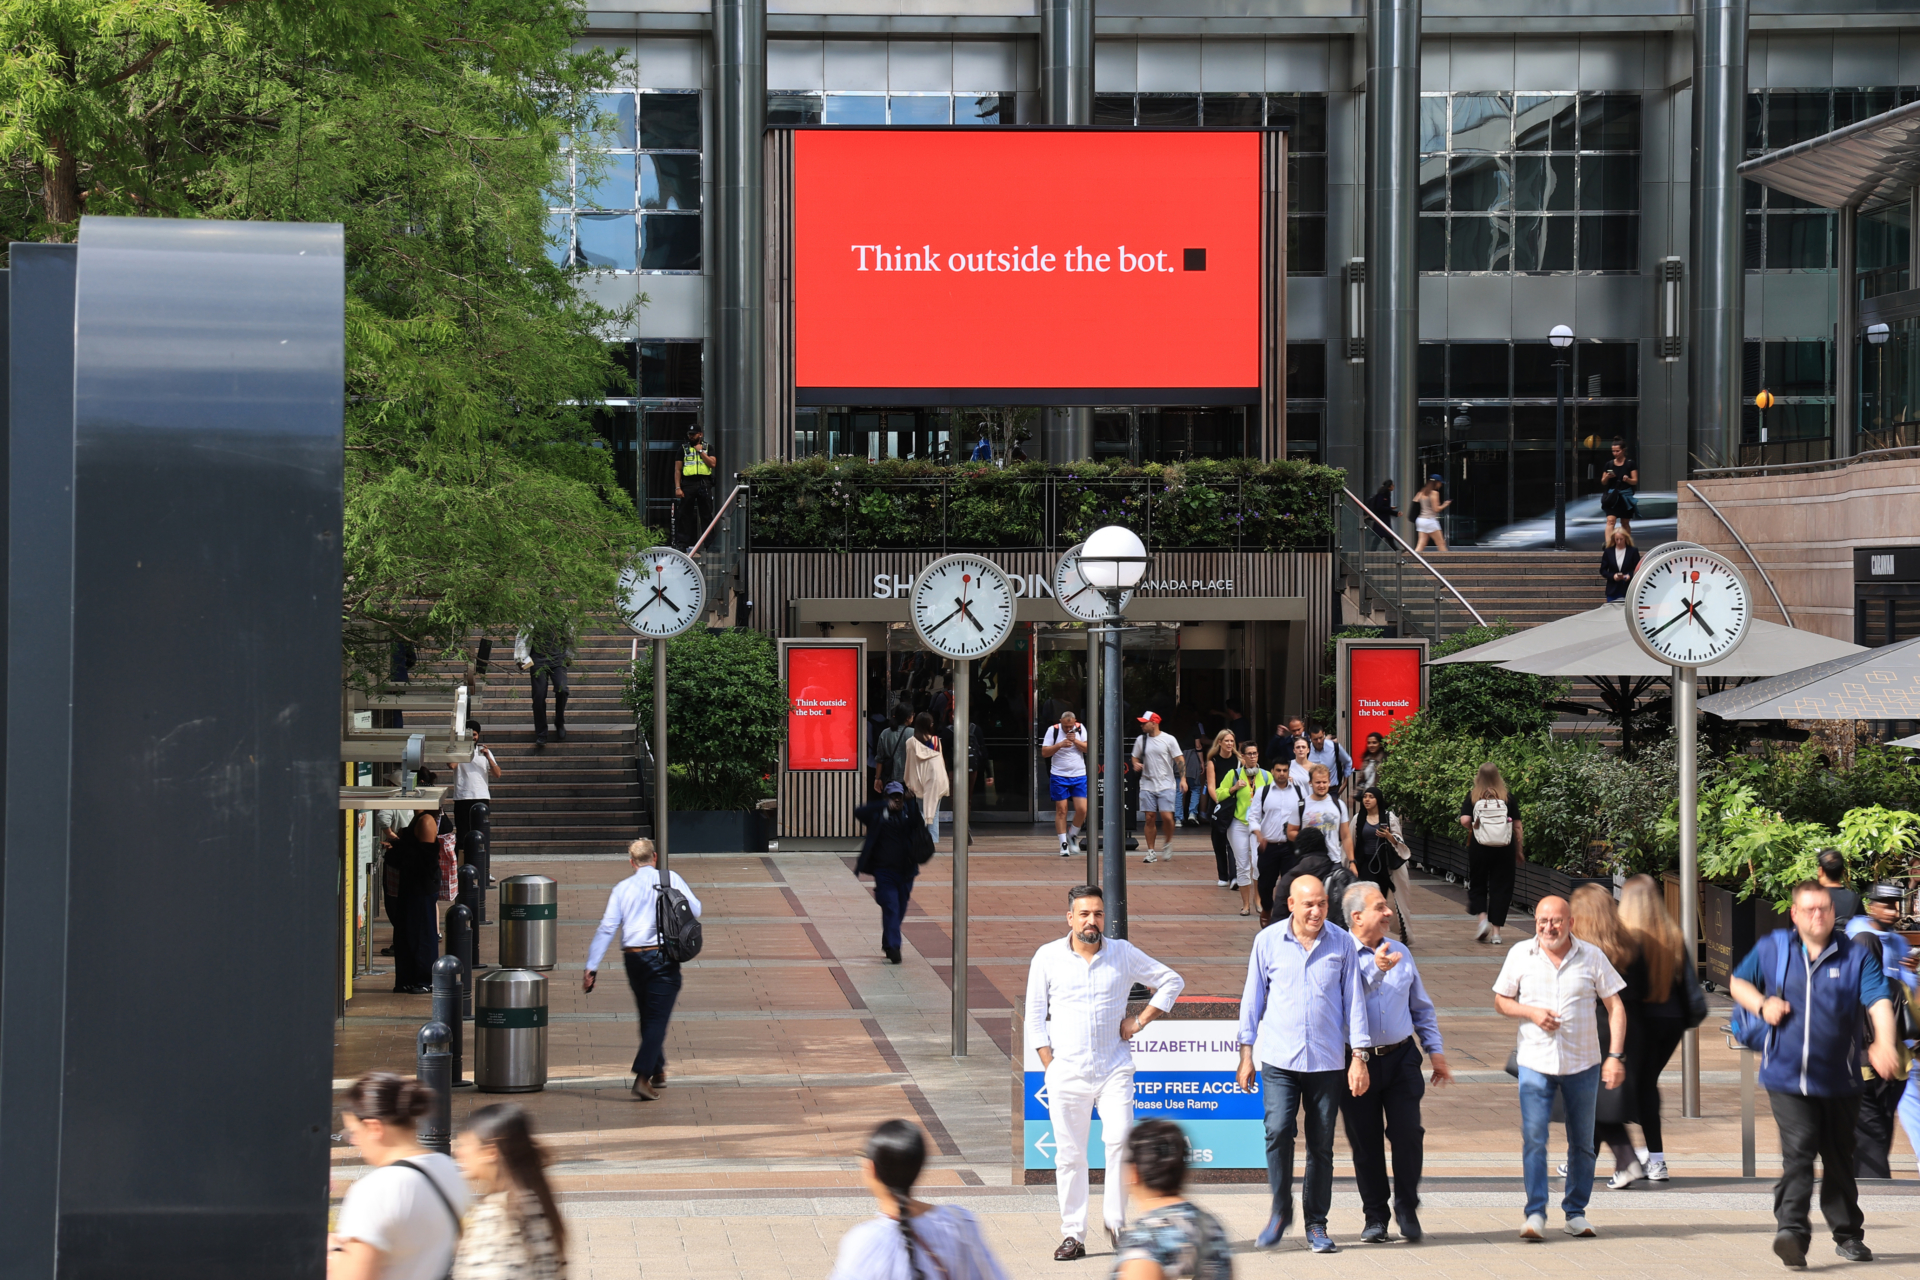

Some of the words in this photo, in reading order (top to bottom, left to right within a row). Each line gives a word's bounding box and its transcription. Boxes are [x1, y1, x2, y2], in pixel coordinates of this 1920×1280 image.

[851, 245, 942, 272] Think
[948, 245, 1056, 272] outside
[1064, 246, 1111, 272] the
[1118, 246, 1175, 273] bot.
[1140, 579, 1188, 590] ANADA
[1191, 579, 1234, 590] PLACE
[795, 698, 818, 707] Think
[819, 698, 847, 707] outside
[1358, 699, 1381, 707] Think
[1382, 699, 1410, 707] outside
[795, 708, 808, 716] the
[809, 708, 824, 716] bot.
[1358, 708, 1371, 717] the
[1372, 708, 1387, 717] bot.
[1129, 1040, 1207, 1053] ELIZABETH
[1165, 1082, 1200, 1094] FREE
[1164, 1099, 1185, 1109] Use
[1187, 1099, 1219, 1111] Ramp
